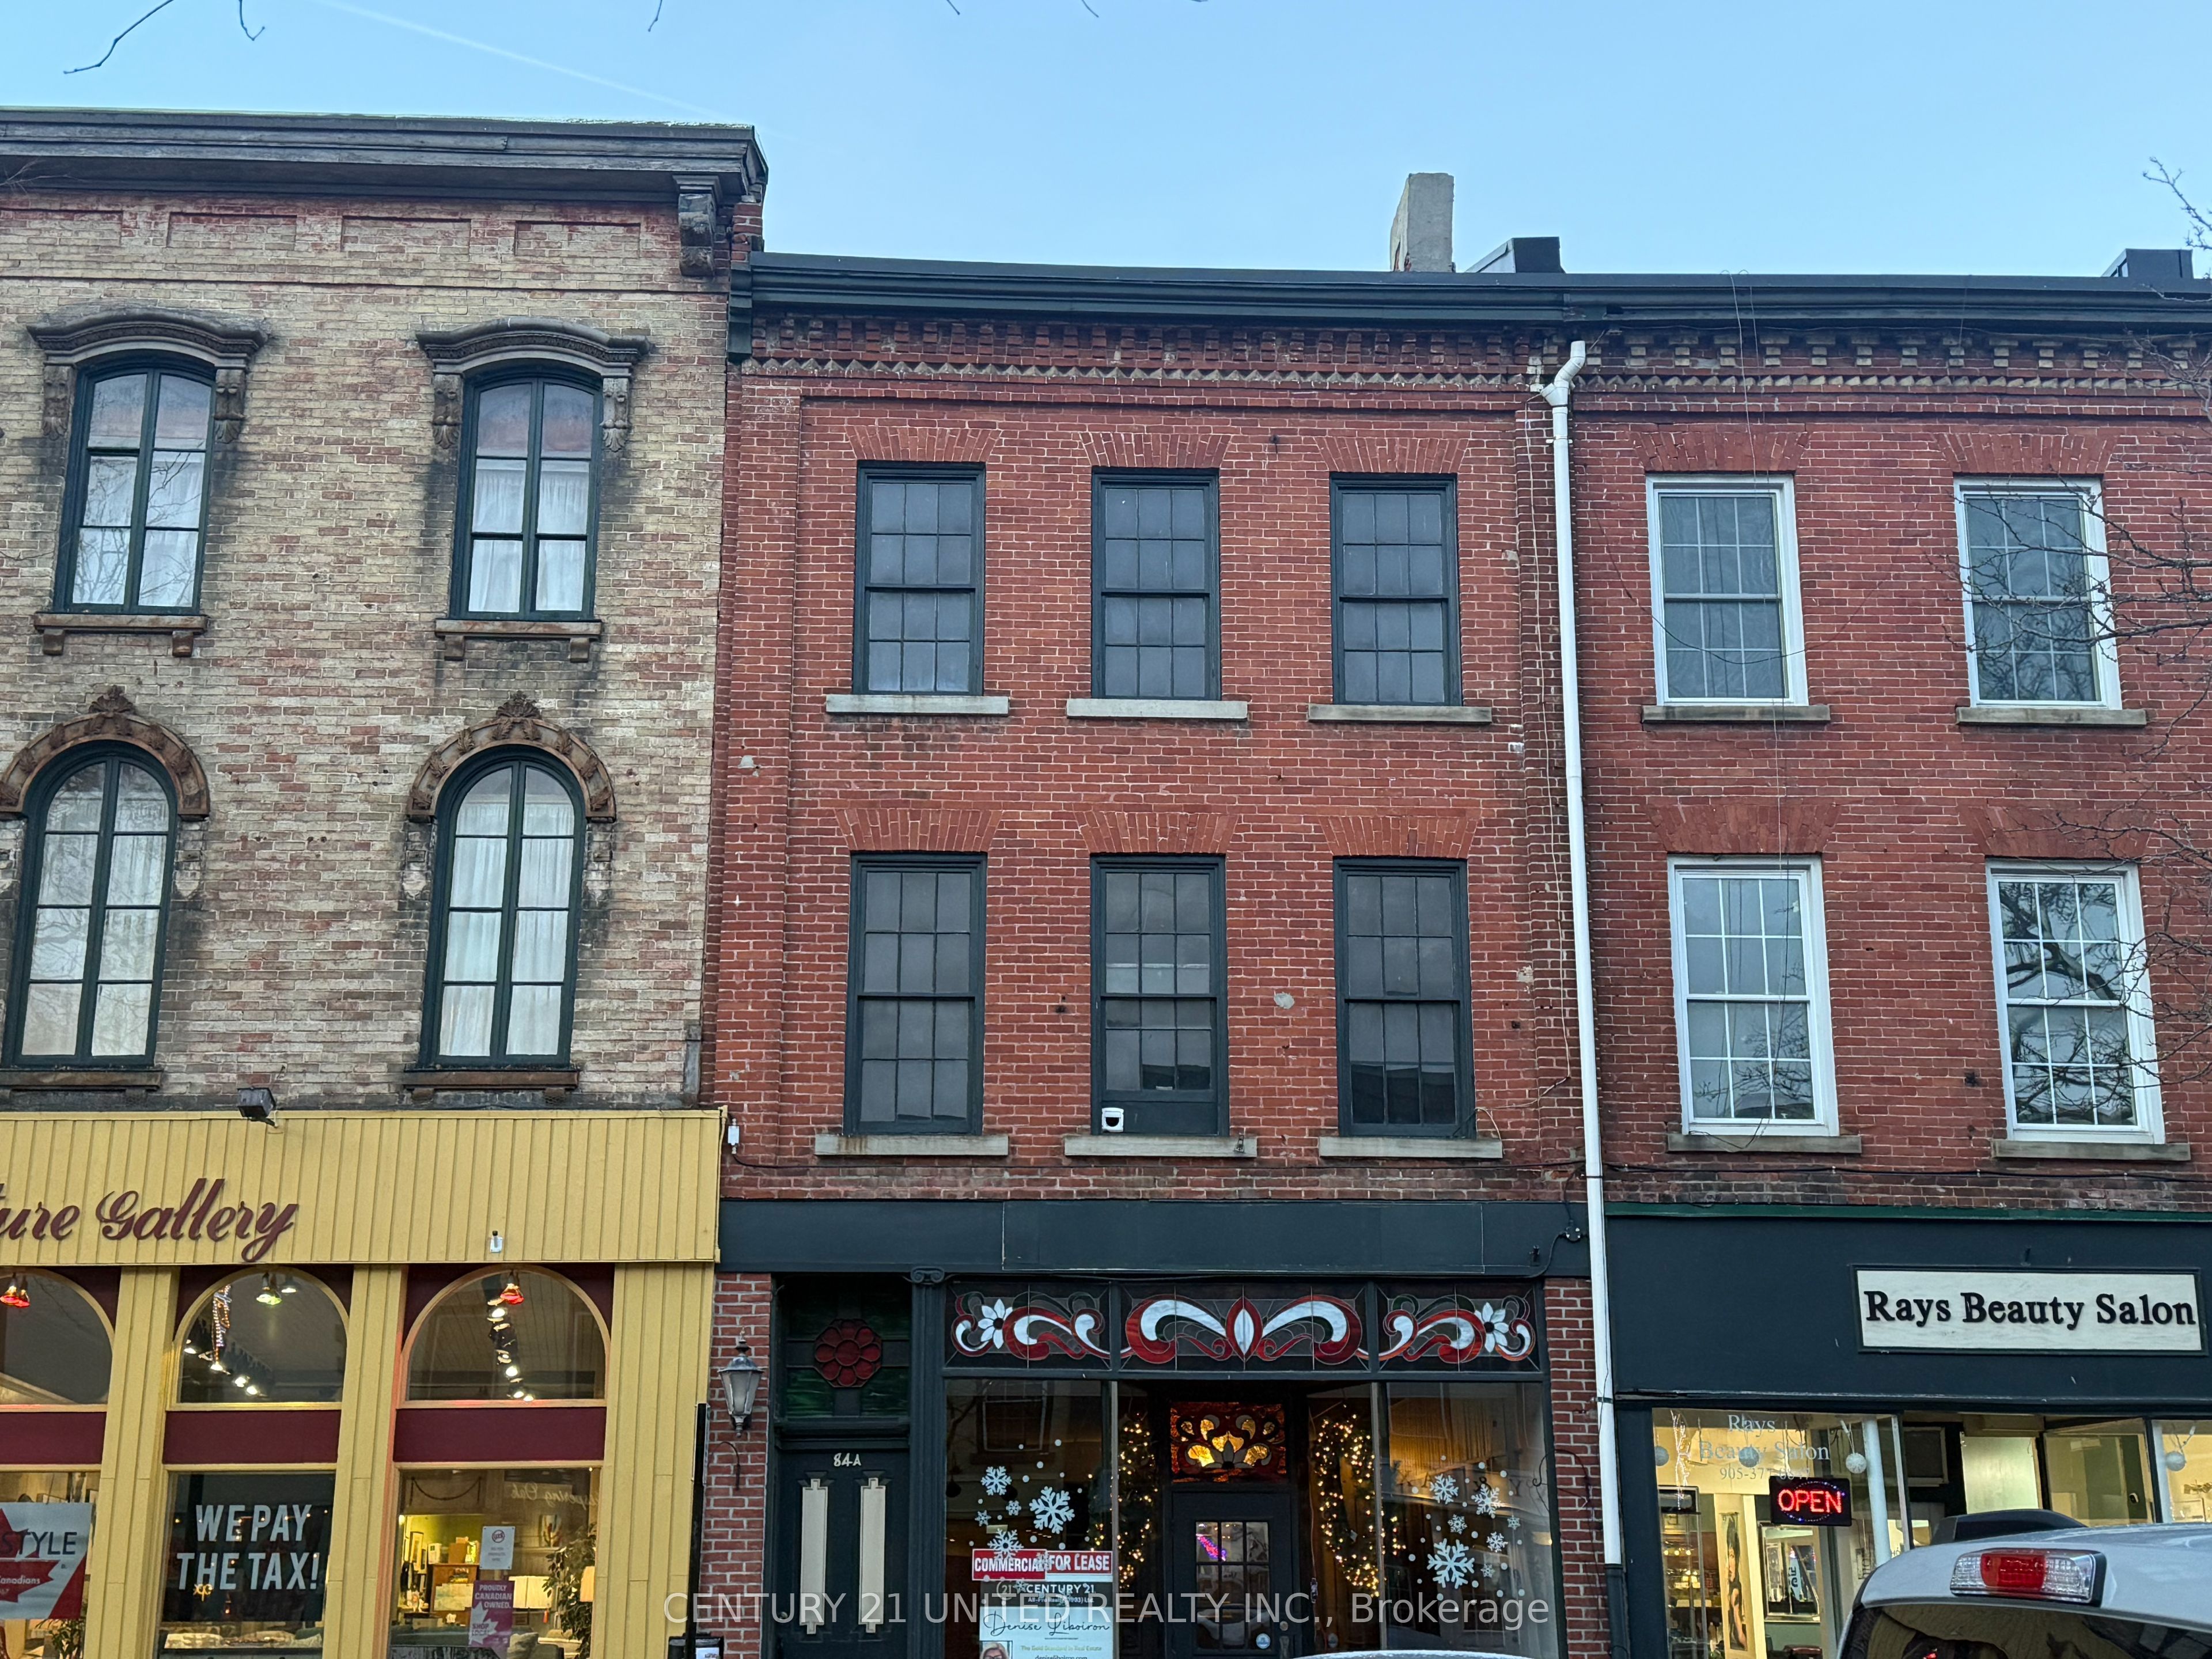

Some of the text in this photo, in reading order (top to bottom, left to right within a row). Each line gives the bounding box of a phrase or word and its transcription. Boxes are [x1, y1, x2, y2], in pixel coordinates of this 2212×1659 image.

[0, 1178, 299, 1262] ure Gallery
[1863, 1291, 2196, 1330] Rays Beauty Salon
[1728, 1415, 1775, 1437] Rays
[834, 1453, 862, 1467] 84A
[1699, 1441, 1830, 1461] Beauty Salon
[1778, 1489, 1842, 1513] OPEN
[196, 1505, 312, 1542] WE PAY
[177, 1552, 320, 1590] THE TAX!
[1048, 1554, 1109, 1571] FOR LEASE
[0, 1574, 40, 1585] anadians
[1026, 1584, 1094, 1594] CENTURY 21
[983, 1611, 1042, 1637] Denise
